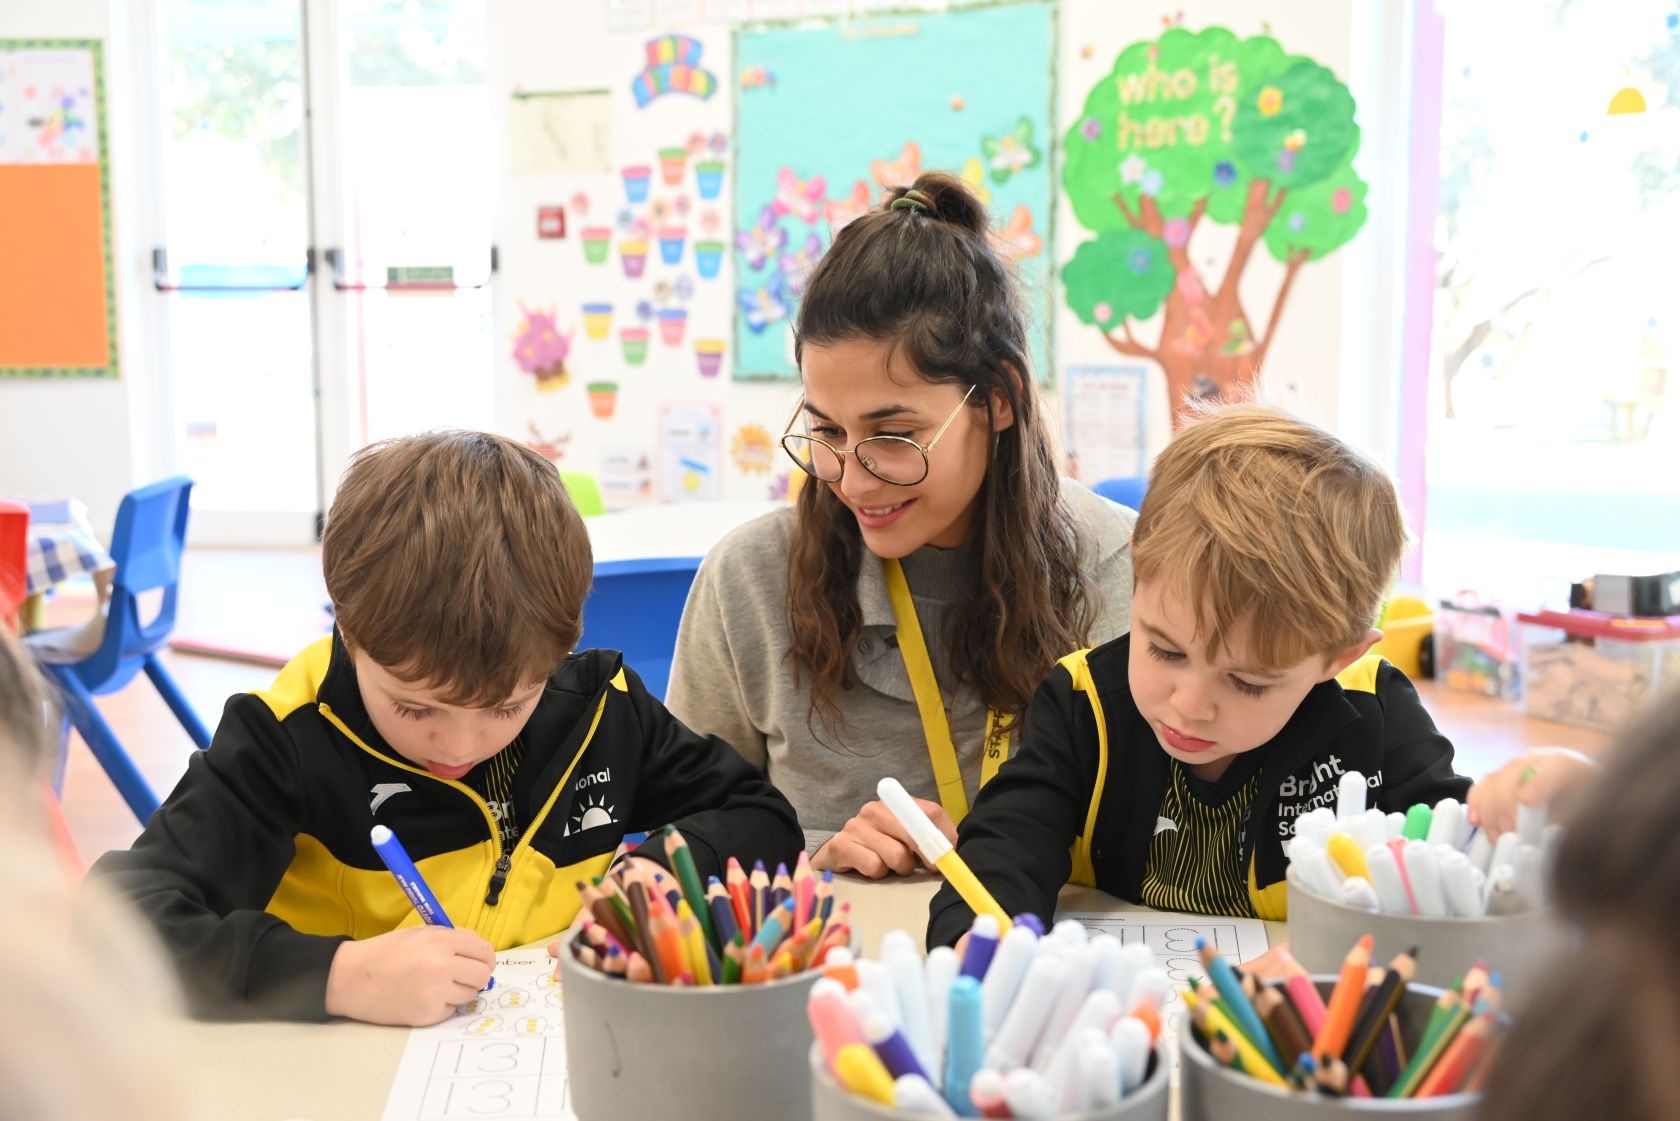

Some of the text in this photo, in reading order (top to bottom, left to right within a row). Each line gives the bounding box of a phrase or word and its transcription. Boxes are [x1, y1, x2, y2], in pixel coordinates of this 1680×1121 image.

[1116, 54, 1239, 105] who is
[454, 1041, 520, 1074] 13
[443, 1079, 514, 1115] 13
